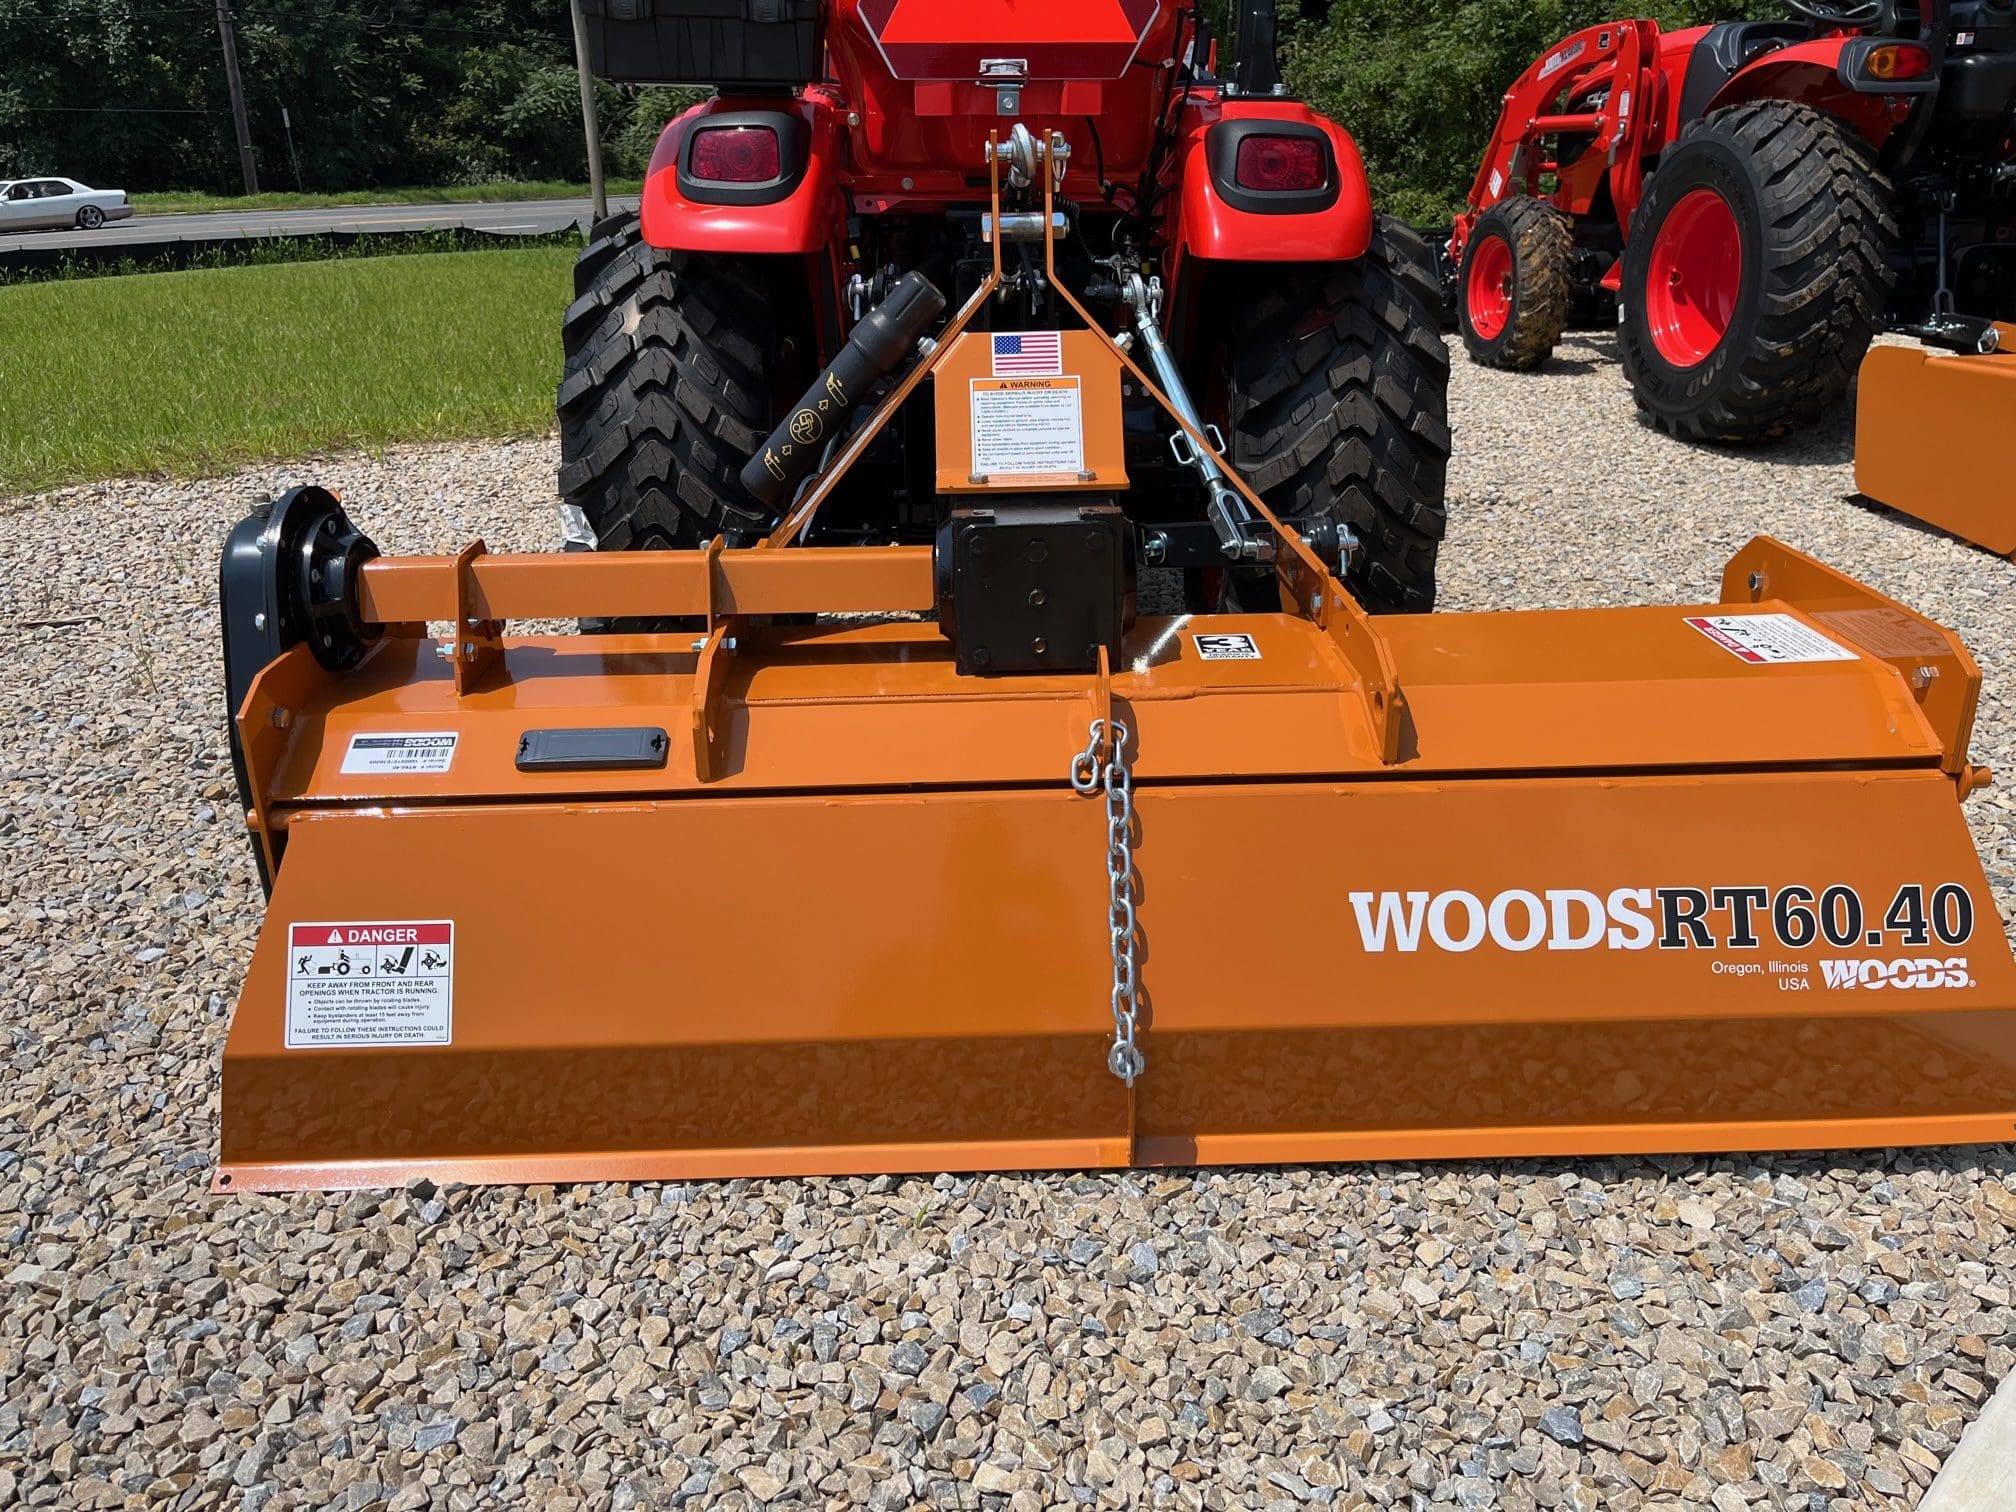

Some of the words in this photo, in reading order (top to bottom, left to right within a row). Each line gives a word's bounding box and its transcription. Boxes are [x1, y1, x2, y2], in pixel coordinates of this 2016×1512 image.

[1348, 888, 1656, 952] WOODS
[348, 928, 418, 943] DANGER
[1711, 961, 1764, 976] Oregon,
[1768, 960, 1809, 973] Illinois
[1779, 978, 1810, 991] USA
